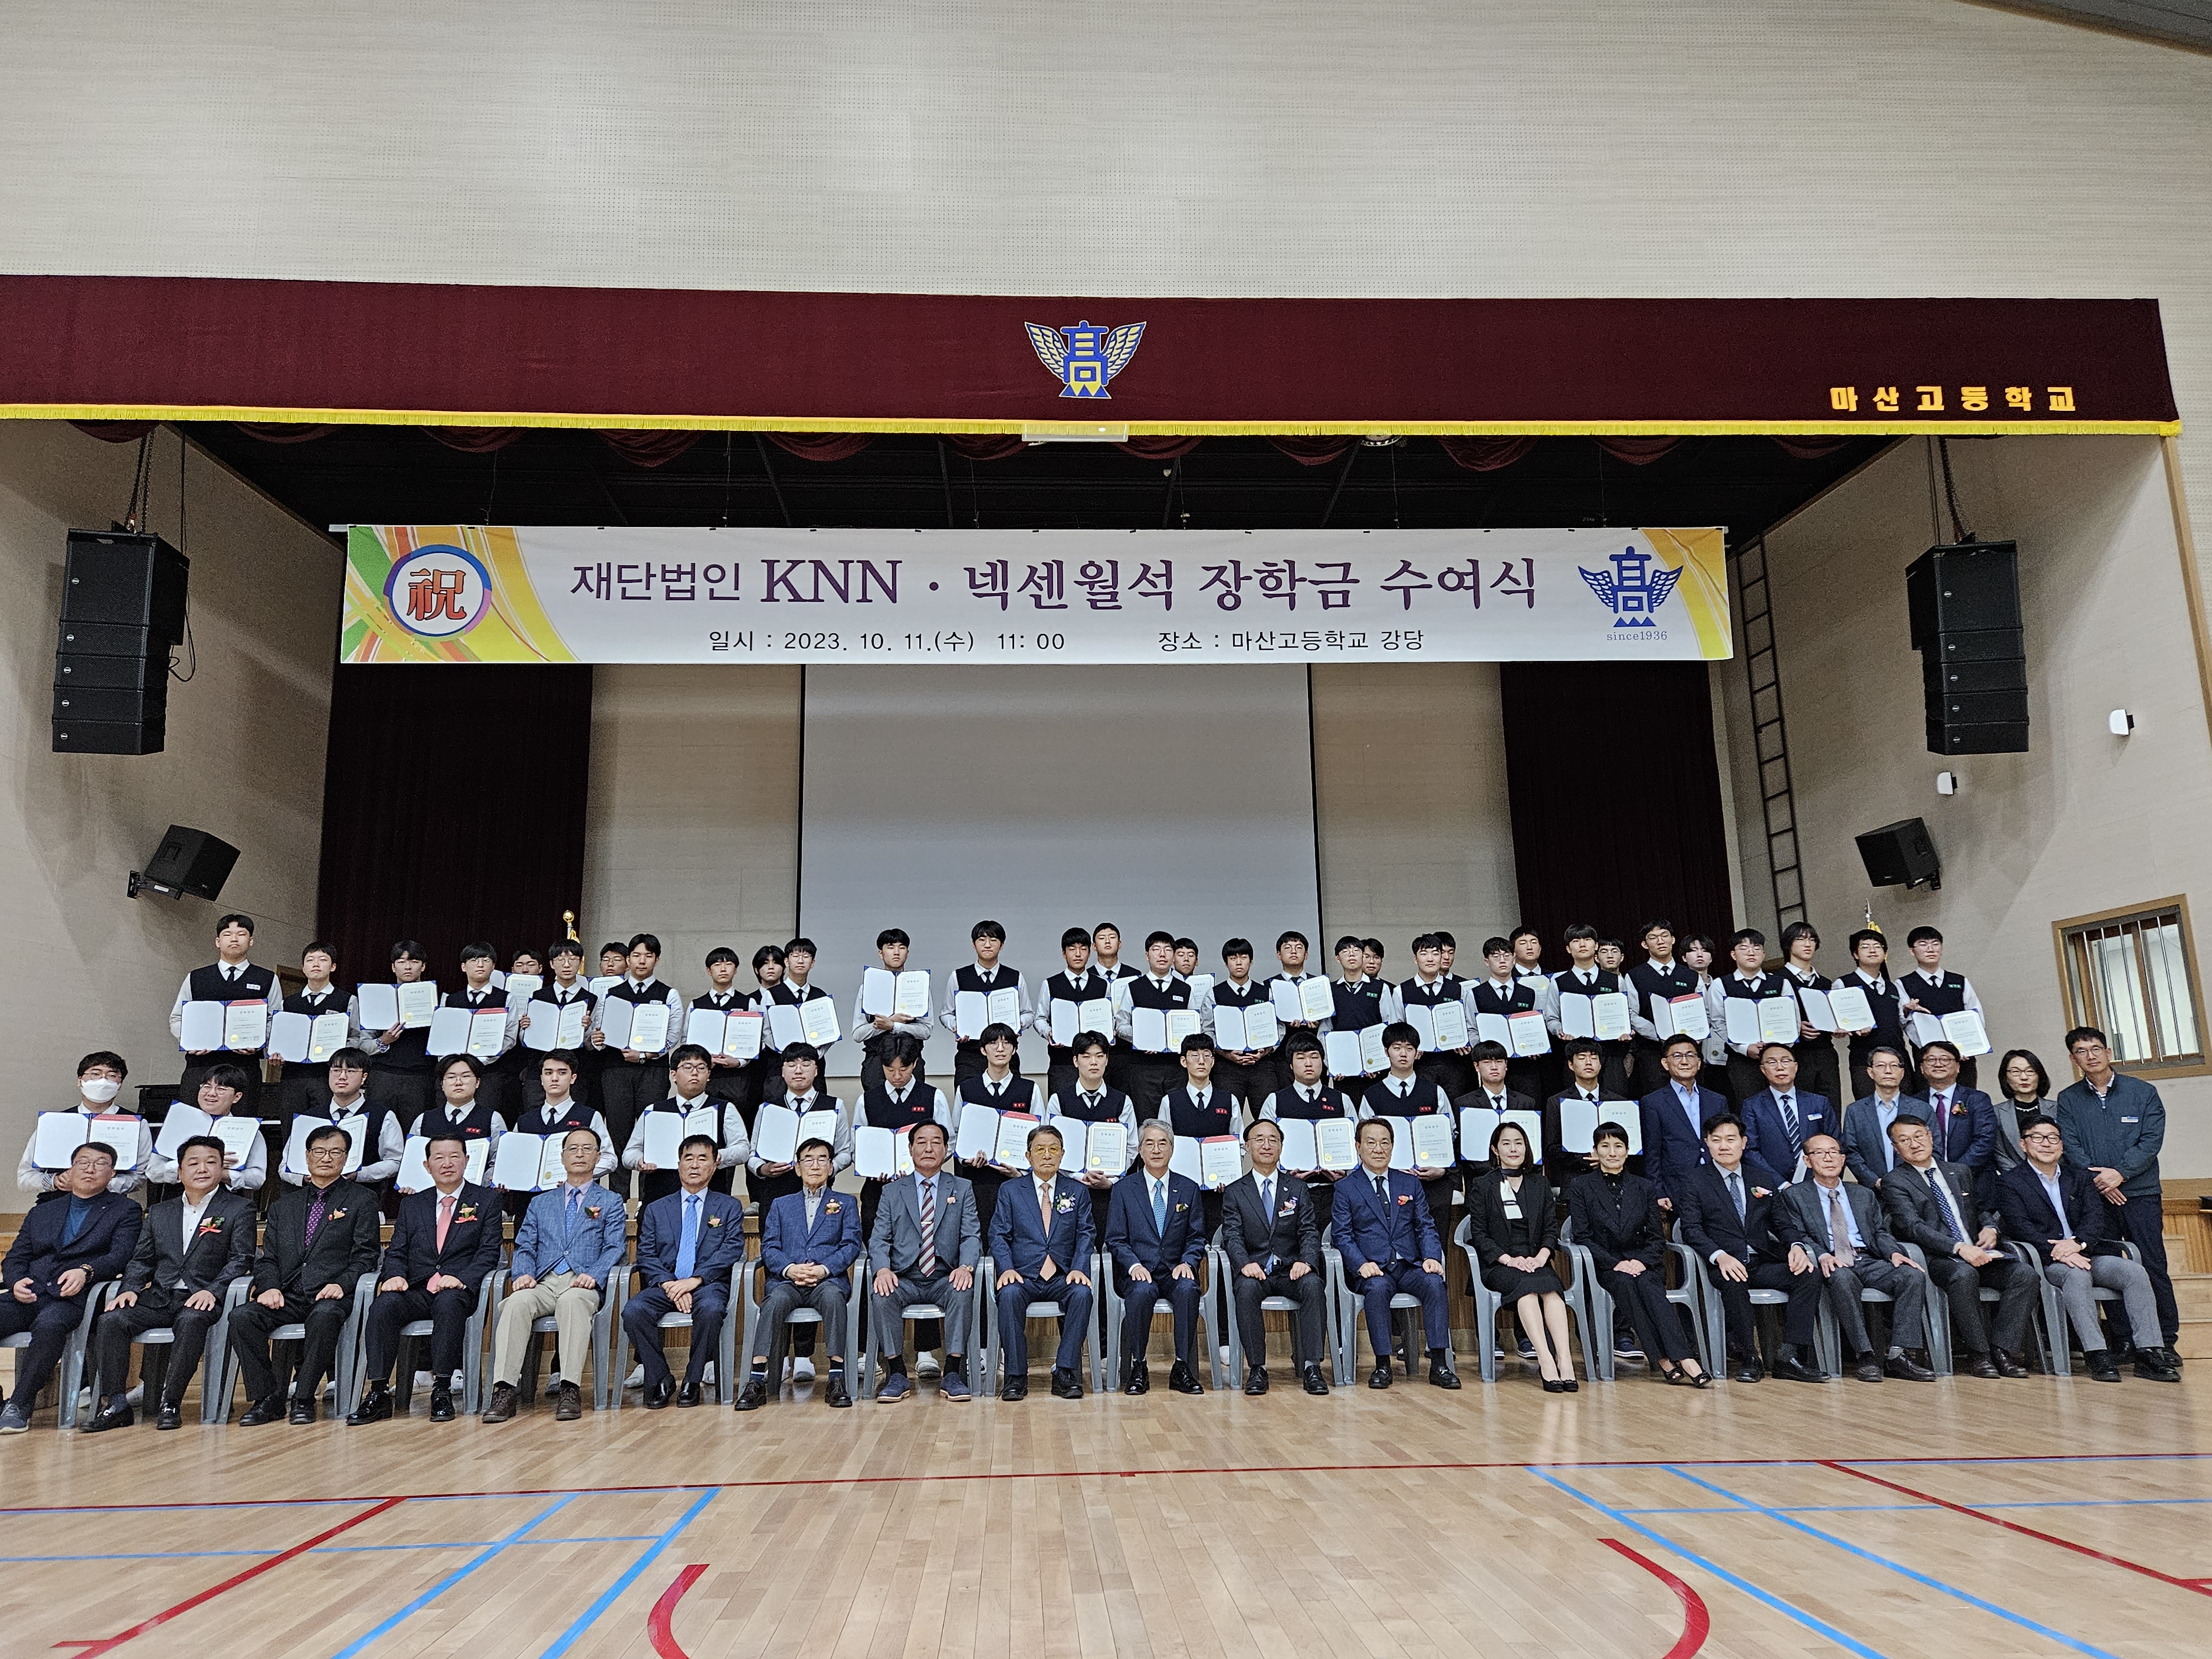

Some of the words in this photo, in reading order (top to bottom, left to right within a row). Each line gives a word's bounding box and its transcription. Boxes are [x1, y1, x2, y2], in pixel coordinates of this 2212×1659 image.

[1830, 385, 2076, 411] 마산고등학교
[406, 568, 467, 621] 祝
[570, 562, 740, 601] 재단법인
[760, 559, 902, 604] KNN
[963, 559, 1173, 612] 넥센월석
[1198, 559, 1360, 612] 장학금
[1380, 557, 1535, 611] 수여식
[709, 630, 753, 651] 일시
[784, 632, 847, 651] 2023.
[860, 633, 891, 651] 10.
[904, 631, 973, 652] 11.(수)
[998, 633, 1024, 650] 11:
[1037, 633, 1065, 650] 00
[1158, 631, 1202, 652] 장소
[1232, 630, 1369, 651] 마산고등학교
[1381, 630, 1424, 651] 강당
[1606, 630, 1667, 641] since1936
